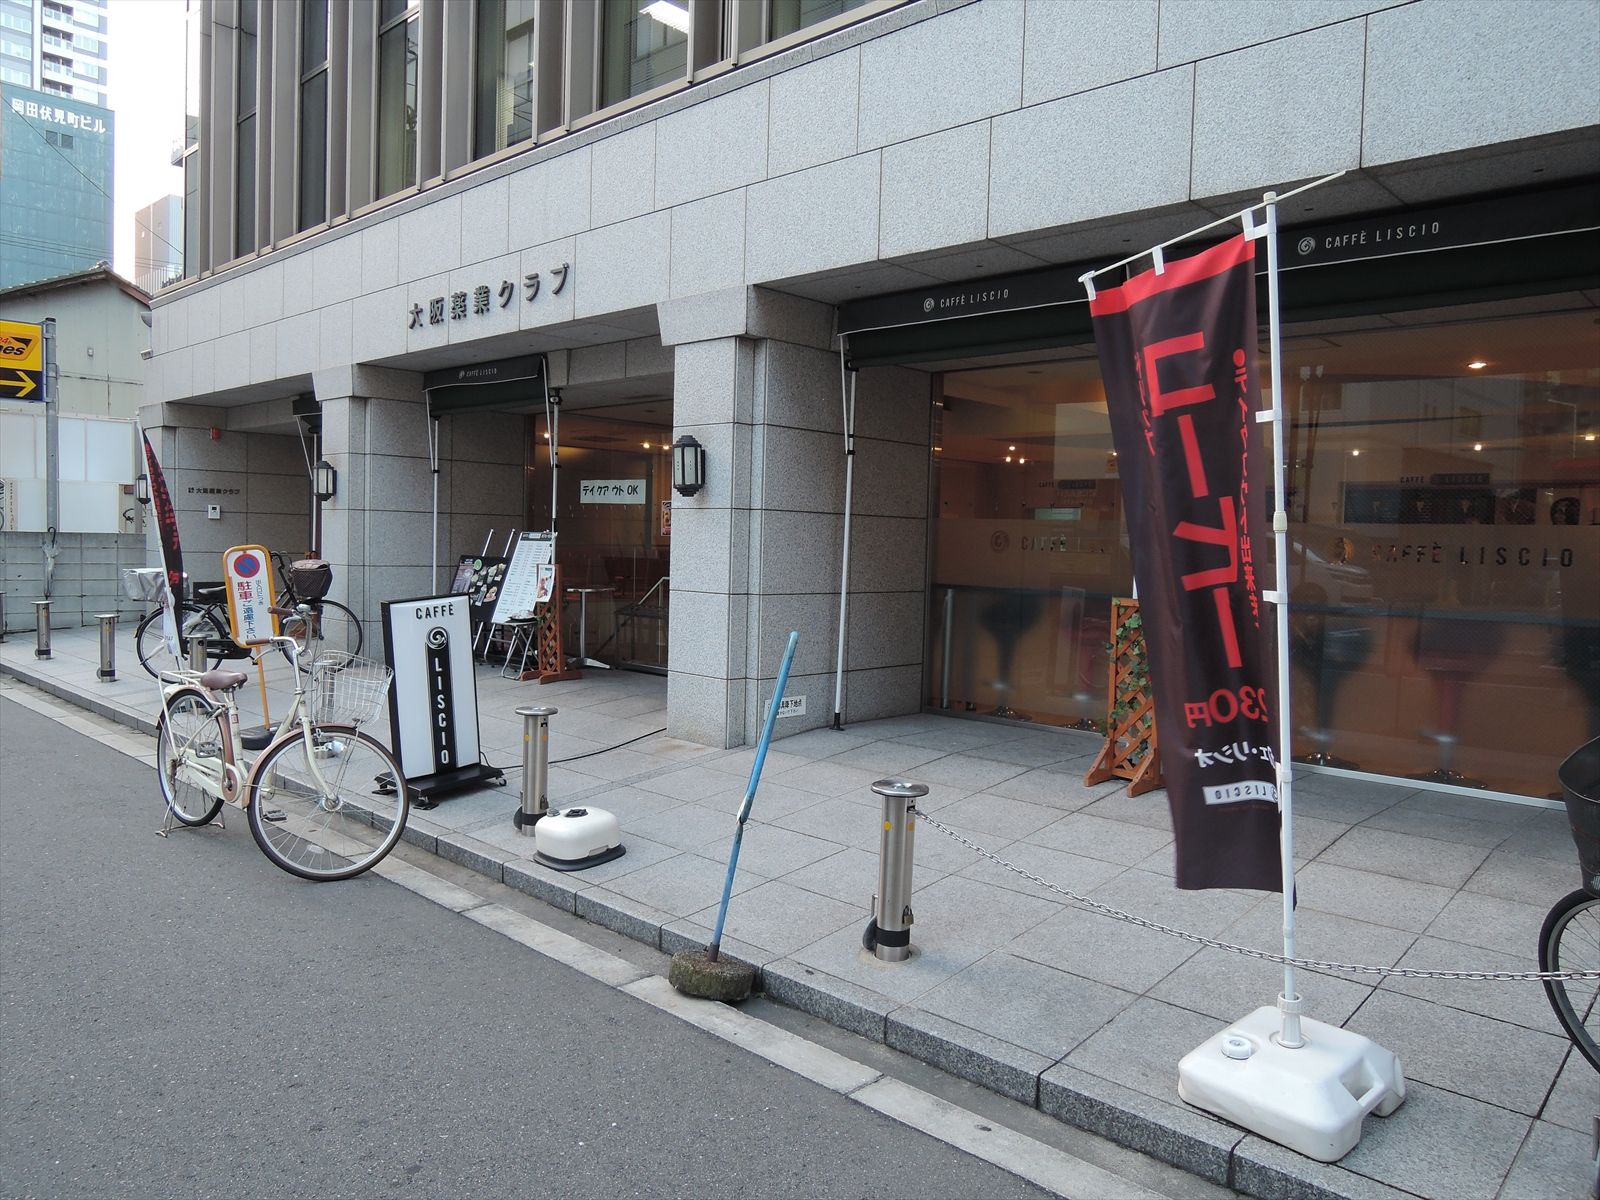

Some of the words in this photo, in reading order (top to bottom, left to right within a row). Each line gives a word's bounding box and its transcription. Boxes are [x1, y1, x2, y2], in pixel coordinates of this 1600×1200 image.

[12, 97, 106, 134] 岡田伏見町ビル
[1325, 230, 1366, 249] CAFFÈ
[1376, 222, 1440, 242] LISCIO
[409, 262, 570, 330] 大阪薬業クラブ
[940, 294, 966, 308] CAFFÈ
[970, 288, 1009, 304] LISCIO
[1459, 547, 1574, 567] LISCIO
[415, 602, 455, 620] CAFFÈ
[434, 657, 450, 765] LISCIO
